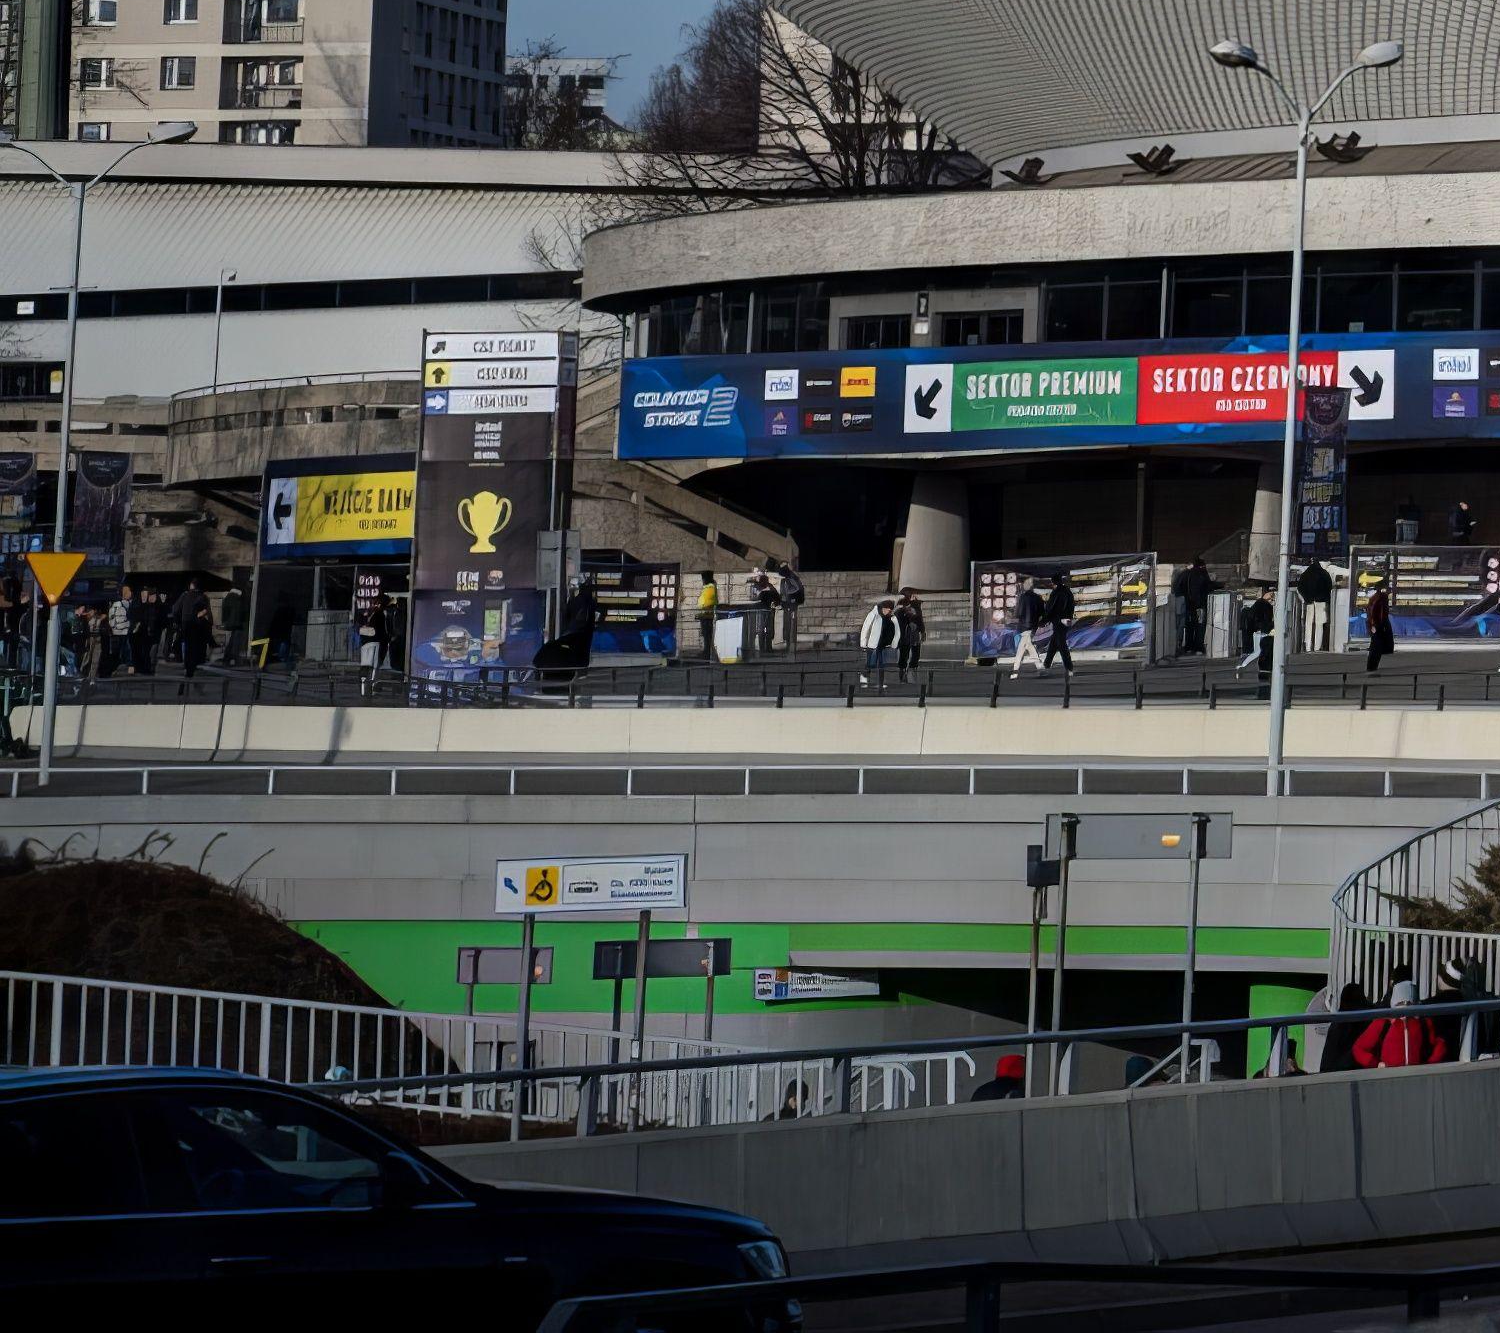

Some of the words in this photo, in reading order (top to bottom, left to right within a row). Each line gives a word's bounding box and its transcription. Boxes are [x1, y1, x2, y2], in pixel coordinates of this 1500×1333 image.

[966, 373, 1032, 400] SEKTOR
[1039, 370, 1122, 397] PREMIUM
[1152, 367, 1225, 393] SEKTOR
